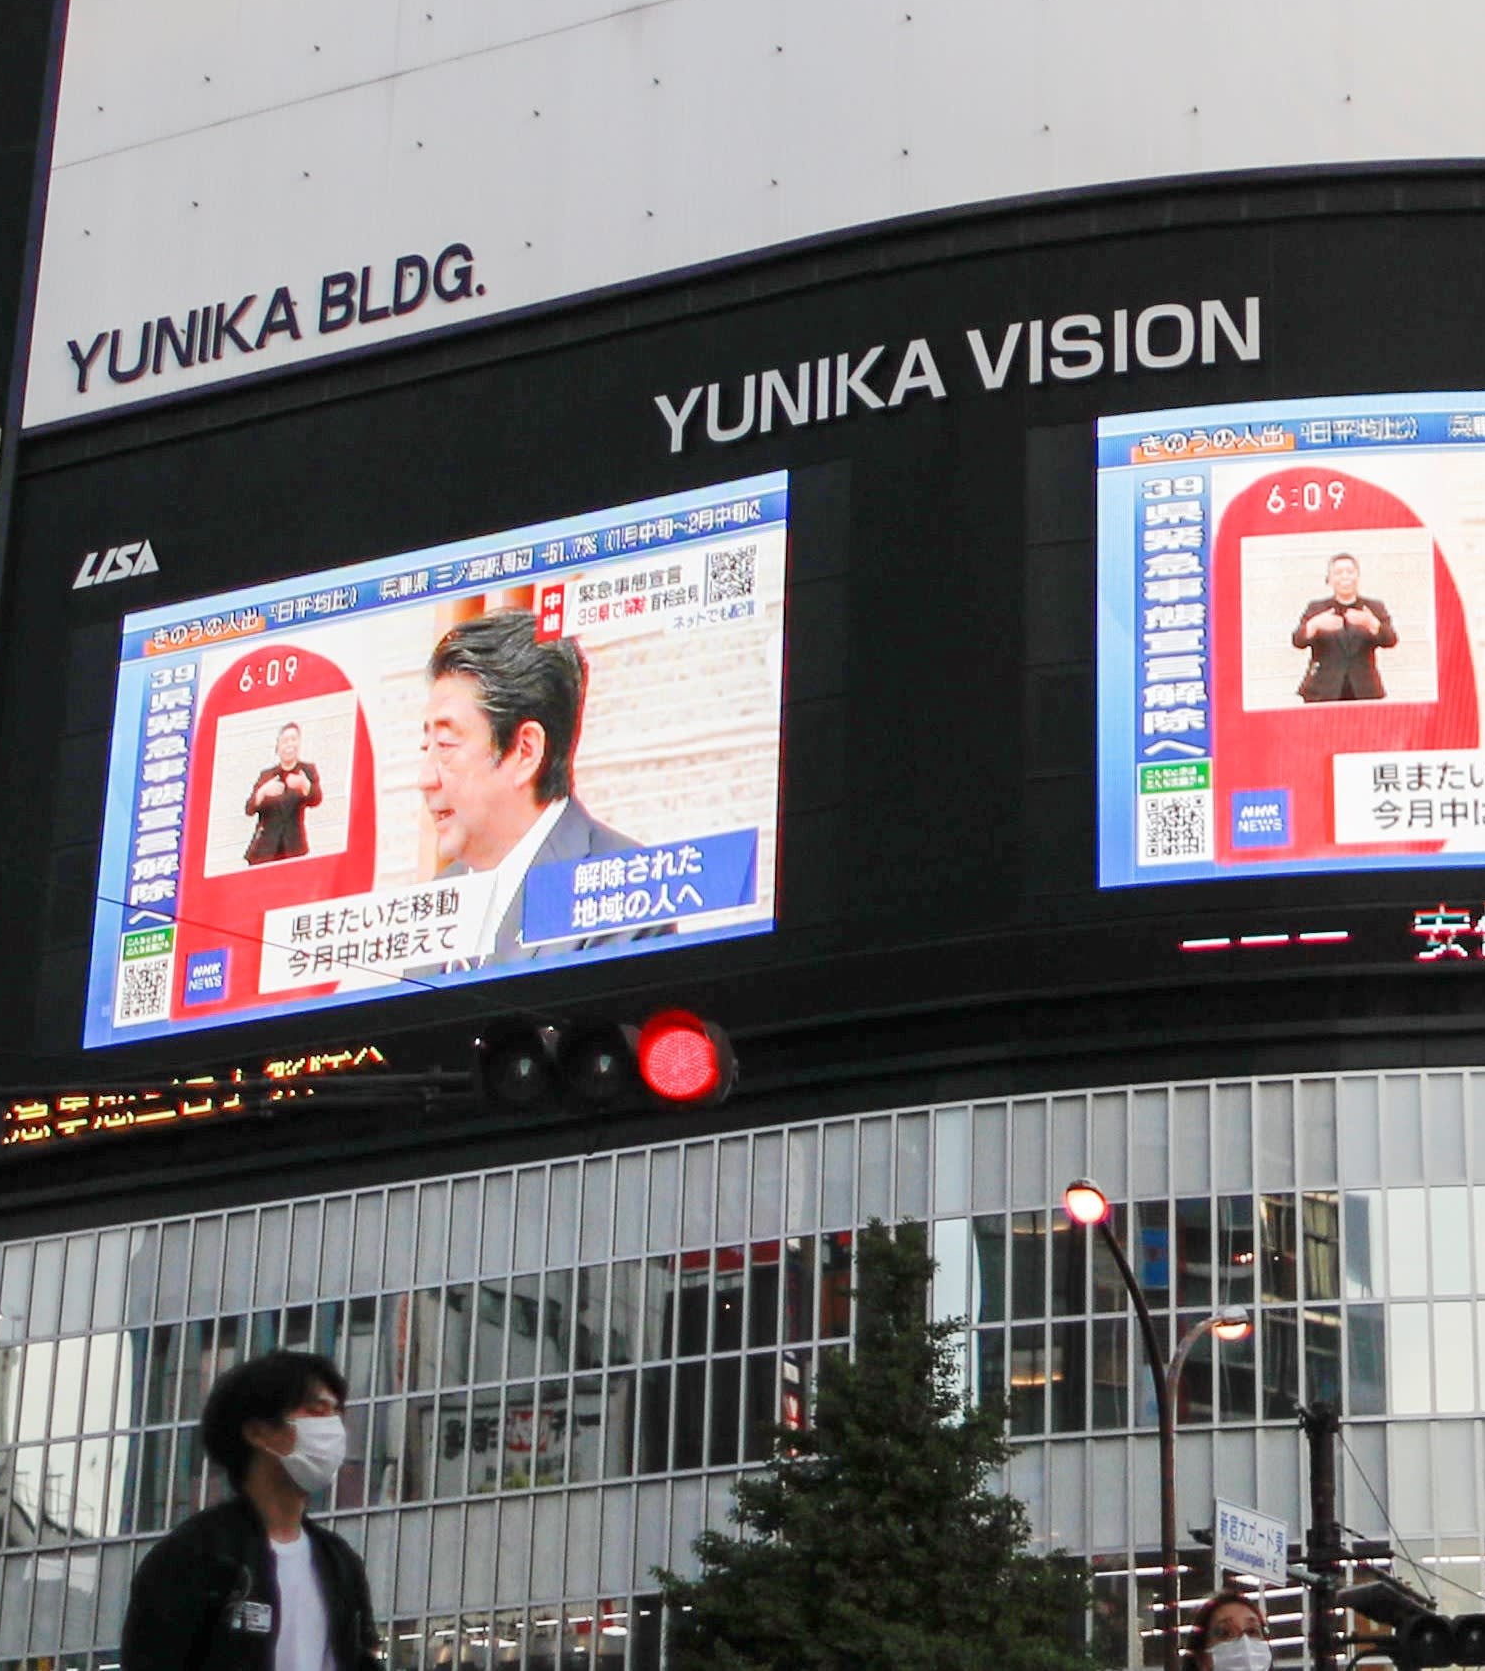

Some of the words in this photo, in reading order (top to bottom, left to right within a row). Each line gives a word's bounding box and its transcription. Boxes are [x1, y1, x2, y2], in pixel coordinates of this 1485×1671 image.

[65, 293, 302, 395] YUNIKA
[316, 241, 488, 333] BLDG.
[655, 339, 947, 454] YUNIKA
[966, 296, 1264, 393] VISION
[1140, 423, 1285, 458] きのうの人出
[1266, 480, 1346, 515] 6:09
[578, 565, 683, 603] 緊急事態宣言
[152, 607, 260, 650] きのうの人出
[238, 655, 299, 694] 6:09
[1237, 817, 1283, 834] NEWS
[573, 844, 704, 895] 解除された
[290, 886, 460, 944] 県またいだ移動
[571, 884, 705, 929] 地域の人へ
[288, 924, 459, 978] 今月中は控えて
[187, 974, 223, 991] NEWS
